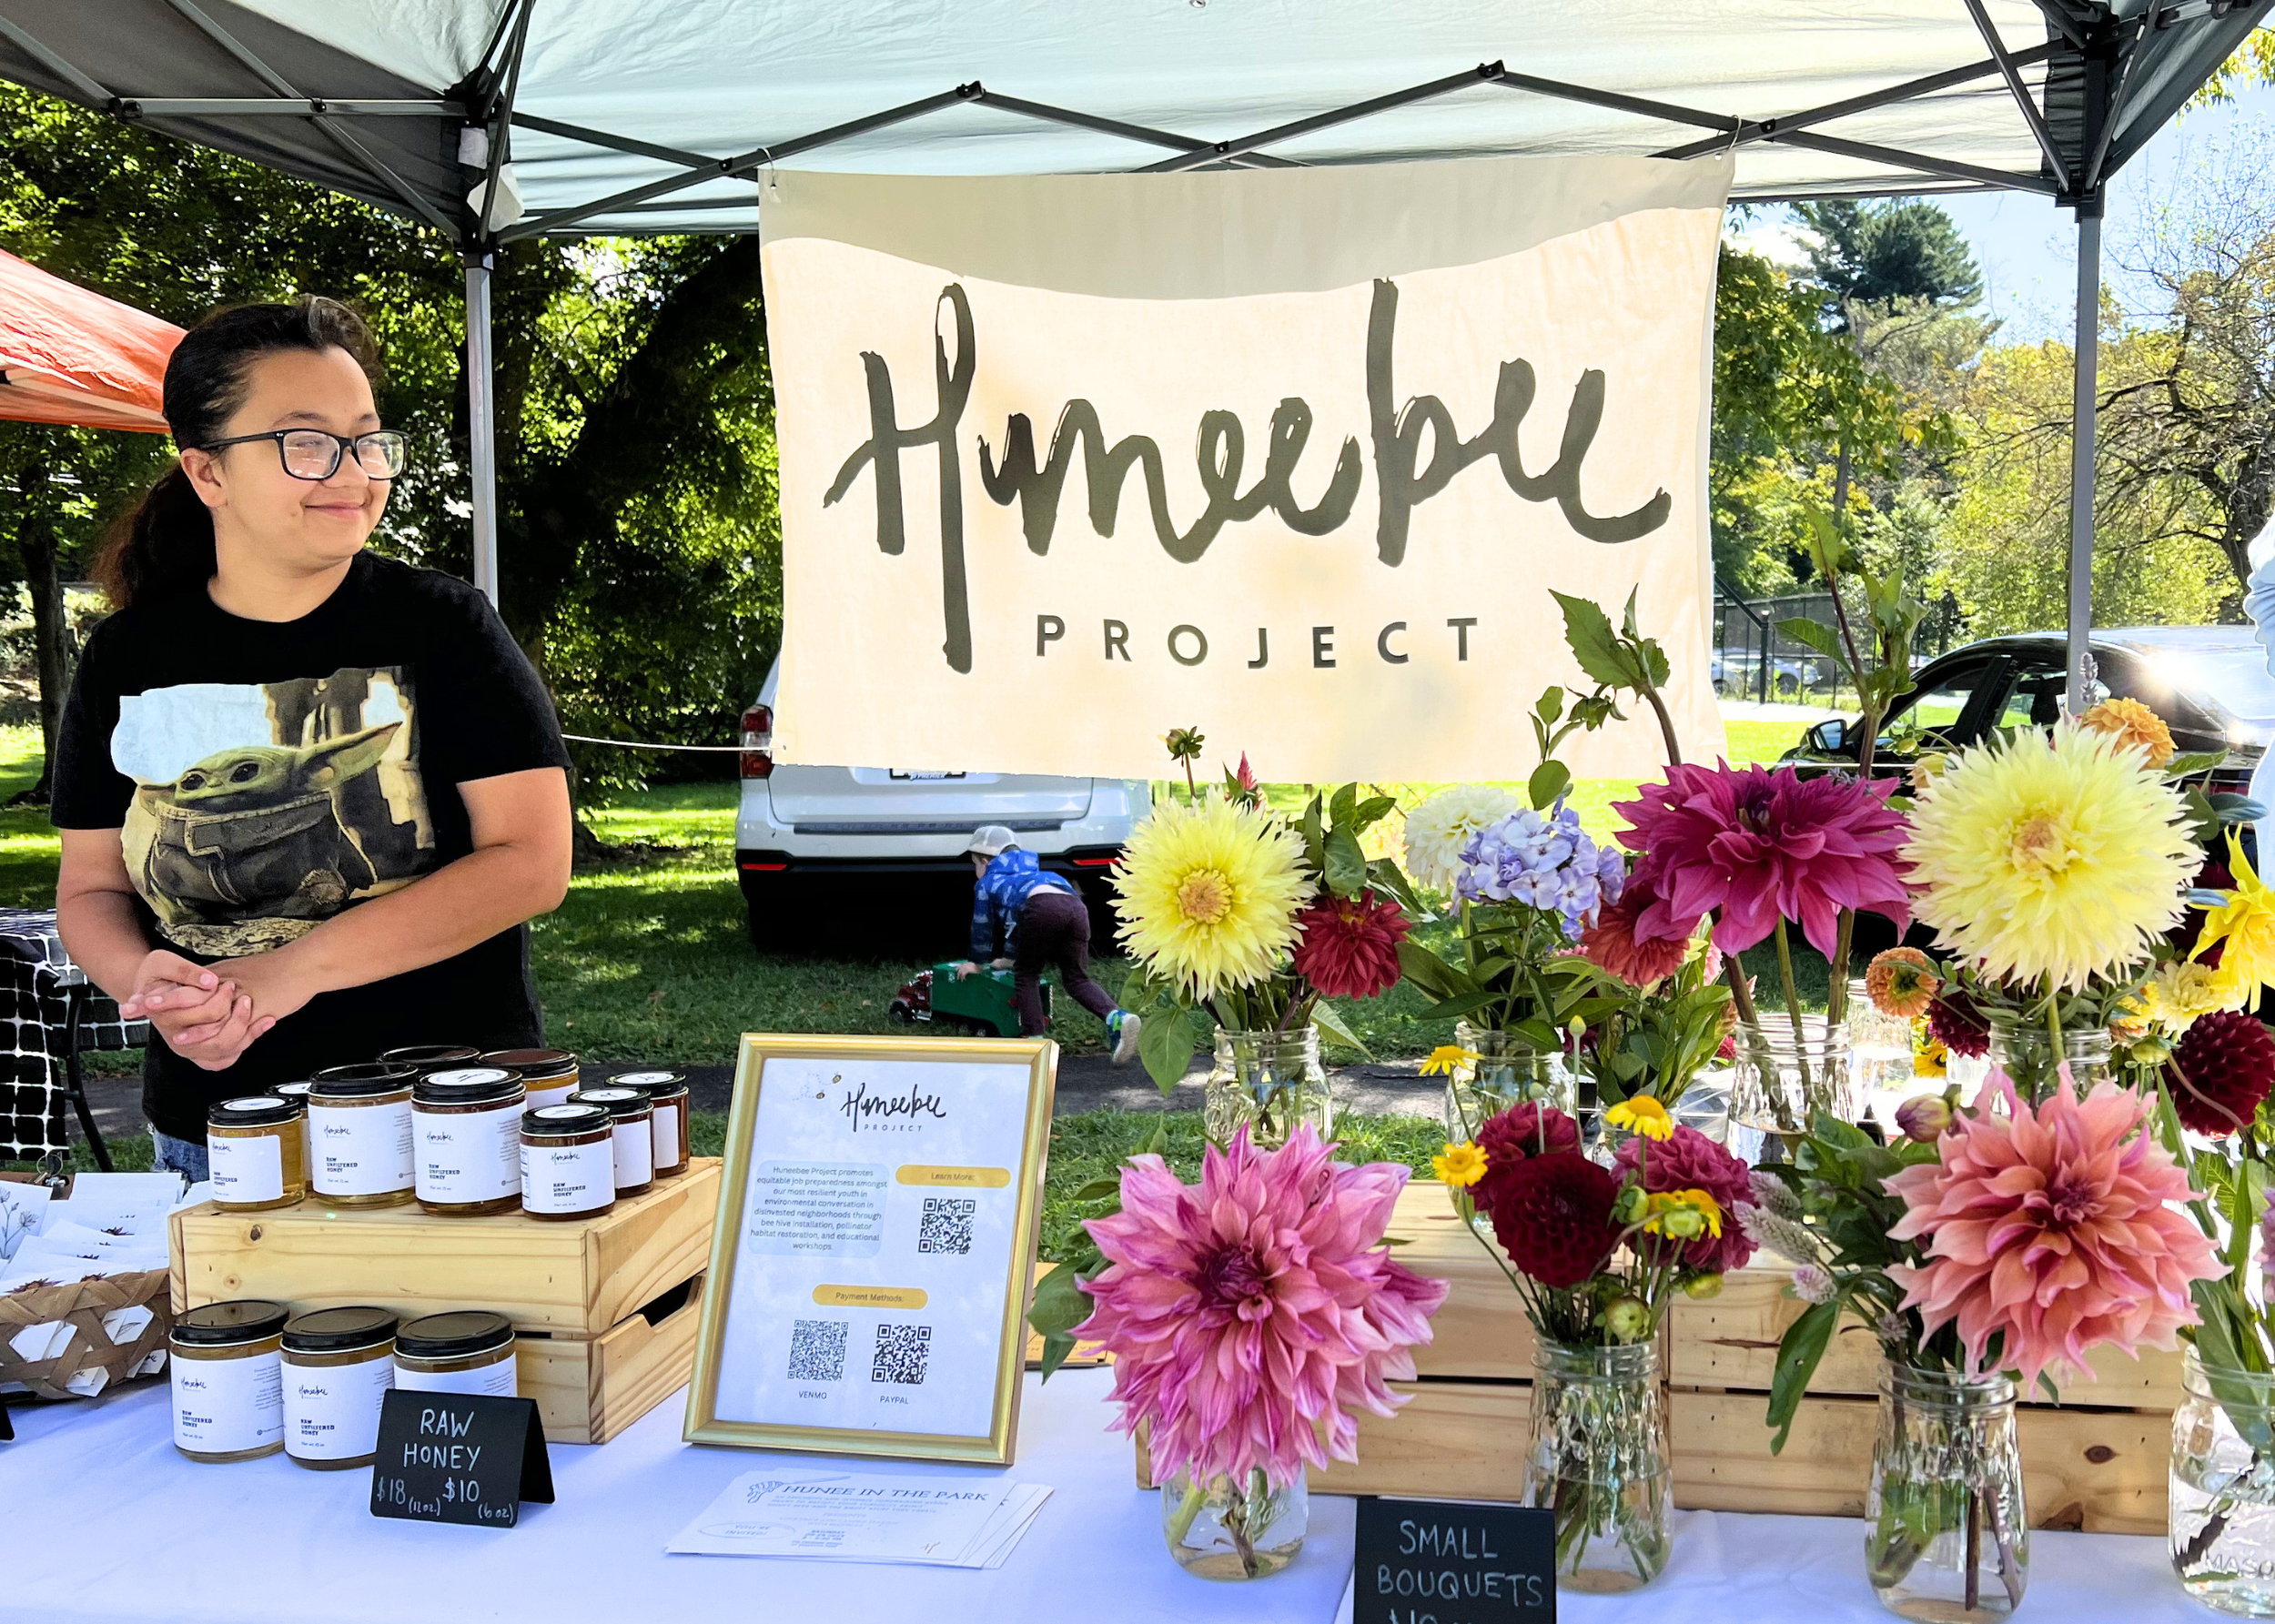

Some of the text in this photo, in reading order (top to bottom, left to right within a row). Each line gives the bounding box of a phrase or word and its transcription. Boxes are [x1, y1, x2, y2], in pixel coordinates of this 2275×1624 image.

[823, 277, 1672, 675] Huneebee
[1036, 614, 1479, 670] PROJECT
[864, 1124, 923, 1132] PROJECT
[773, 1166, 874, 1178] Huneebee Project promotes
[954, 1174, 976, 1182] More:
[756, 1176, 888, 1189] equitable job preparedness amongst
[807, 1188, 836, 1196] resilient
[837, 1190, 860, 1198] youth
[764, 1198, 817, 1206] environmental
[817, 1200, 865, 1208] conversation
[753, 1207, 882, 1221] disinvested neighborhoods through
[761, 1218, 774, 1226] bee
[792, 1219, 834, 1229] installation,
[835, 1222, 873, 1230] pollinator
[750, 1228, 880, 1242] habitat restoration, and educational
[793, 1241, 834, 1251] workshops.
[835, 1292, 905, 1303] Payment Methods:
[798, 1390, 827, 1400] VENMO
[879, 1395, 909, 1405] PAYPAL
[420, 1408, 475, 1438] RAW
[402, 1442, 481, 1472] HONEY
[376, 1475, 407, 1506] $18
[442, 1476, 480, 1503] $10
[782, 1485, 855, 1496] HUNEE
[858, 1488, 886, 1497] IN
[892, 1488, 932, 1498] THE
[934, 1491, 990, 1501] PARK
[1399, 1519, 1498, 1560] SMALL
[1377, 1564, 1543, 1608] BOUQUETS
